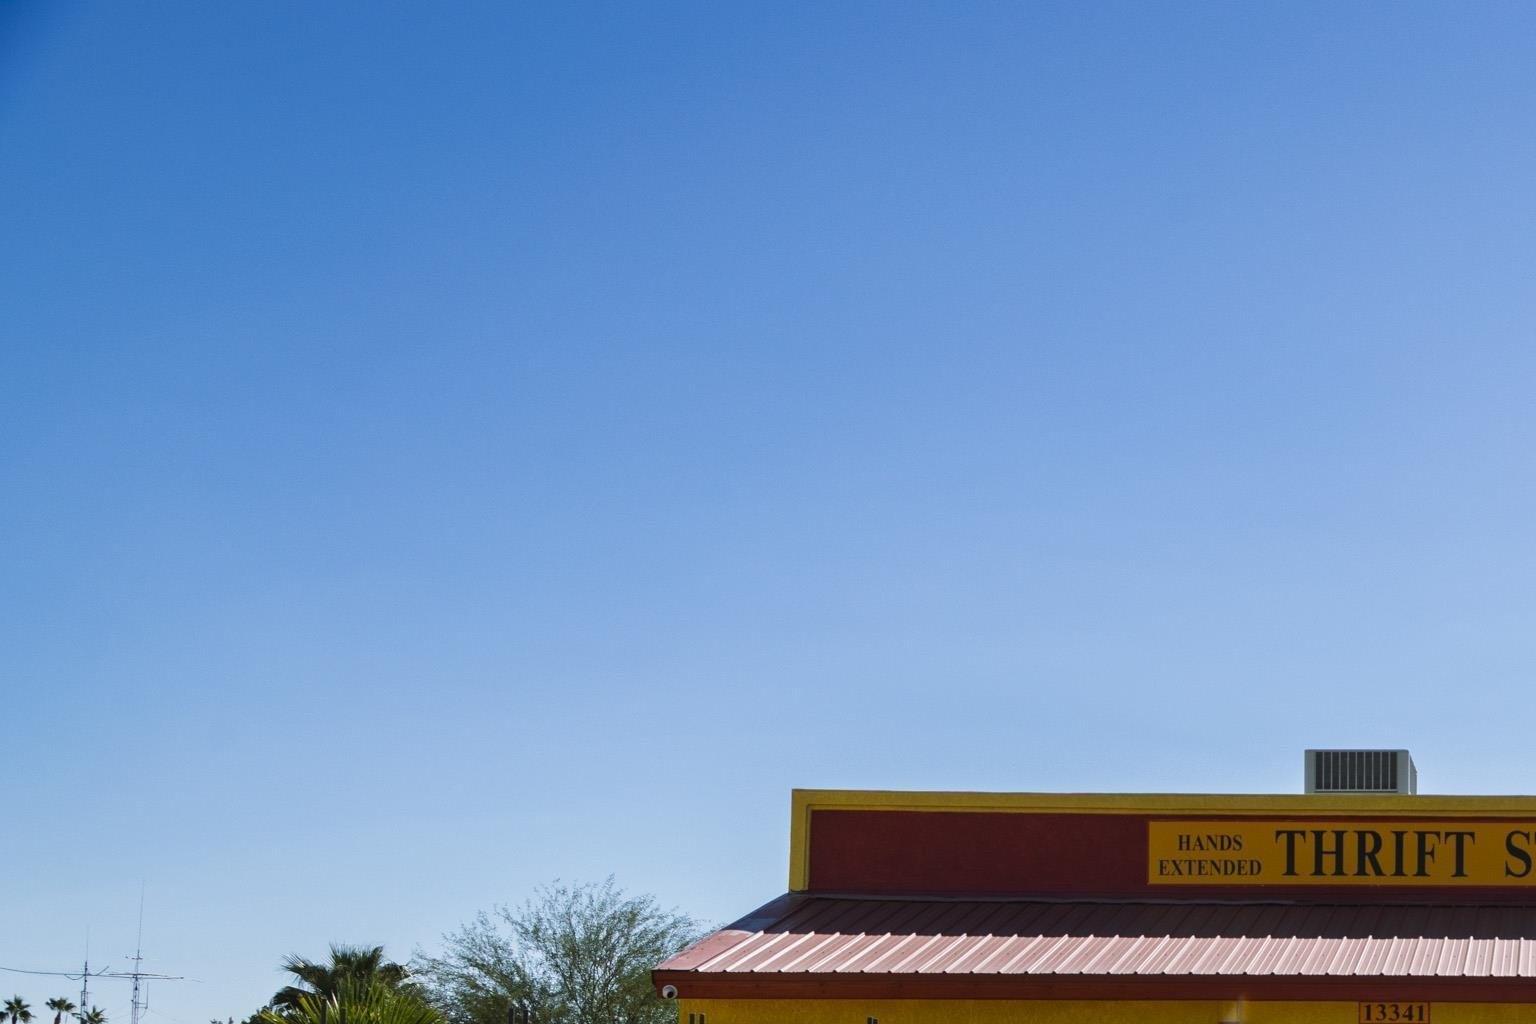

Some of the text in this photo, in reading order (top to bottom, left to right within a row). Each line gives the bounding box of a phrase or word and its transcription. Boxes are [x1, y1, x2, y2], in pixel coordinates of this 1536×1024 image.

[1177, 834, 1243, 851] HANDS
[1275, 829, 1475, 878] THRIFT
[1158, 859, 1262, 877] EXTENDED
[1363, 1003, 1424, 1021] 13341
